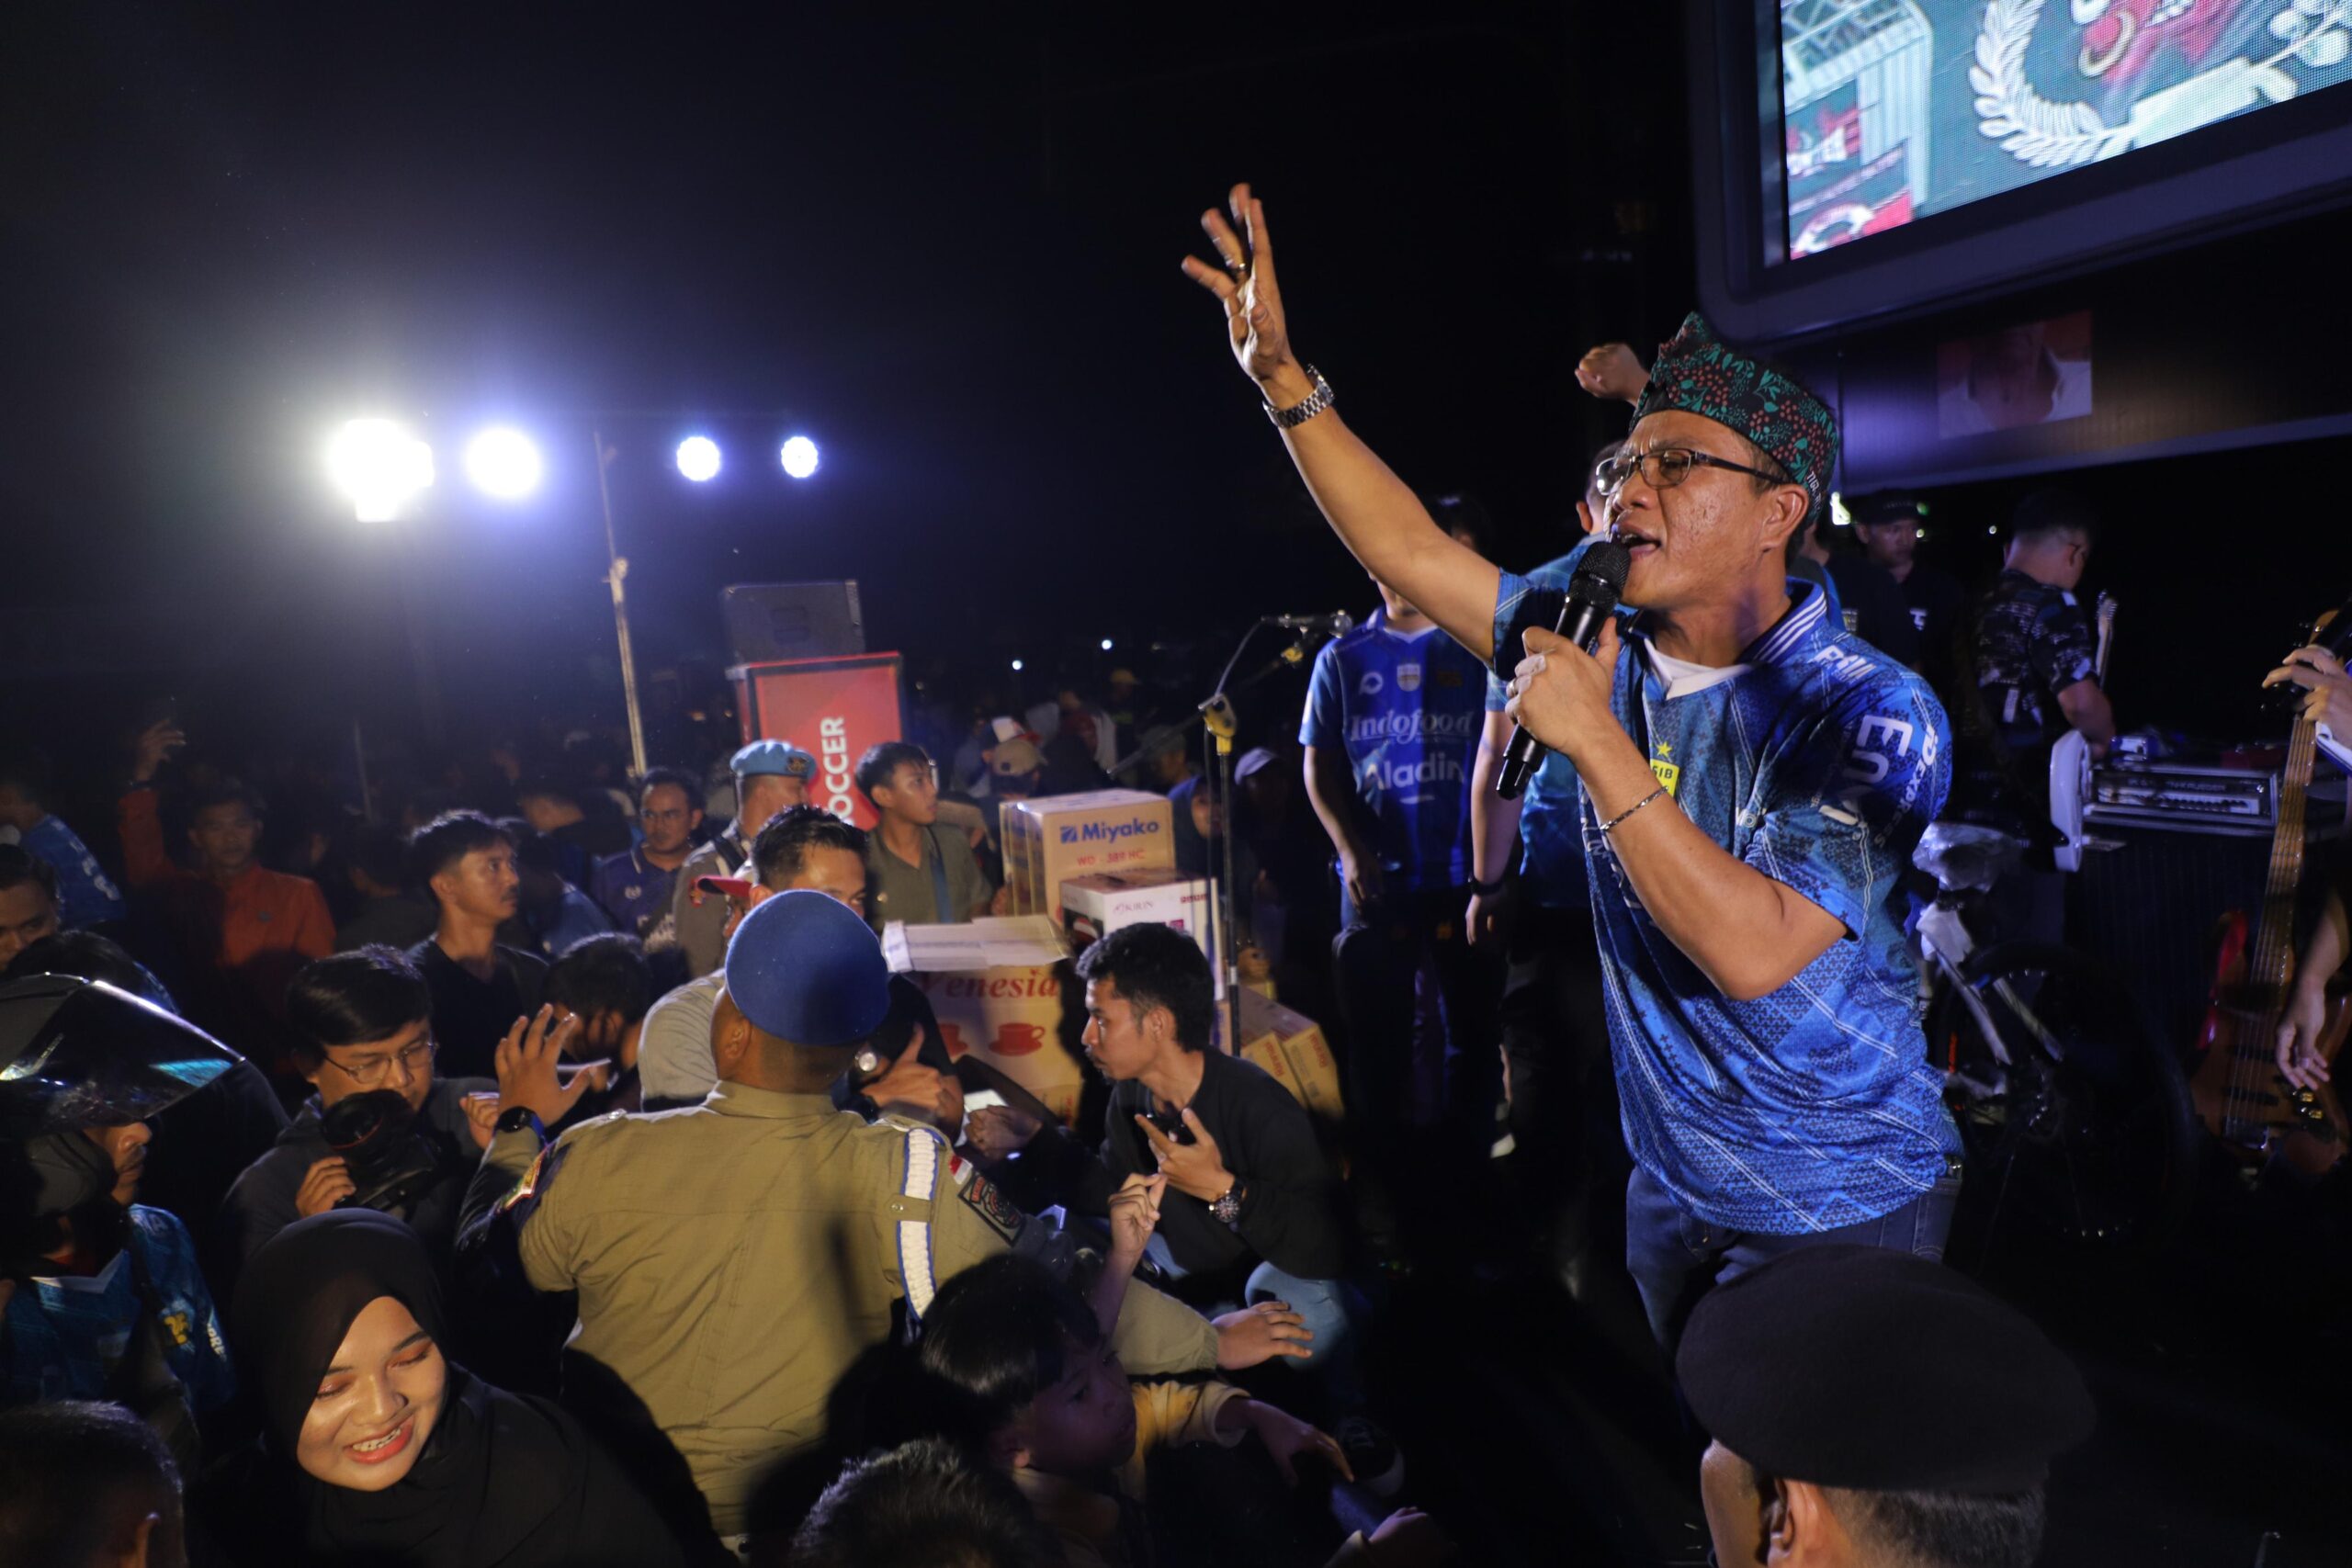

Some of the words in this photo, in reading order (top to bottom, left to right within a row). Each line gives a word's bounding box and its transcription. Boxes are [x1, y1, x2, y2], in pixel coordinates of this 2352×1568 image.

[1350, 707, 1475, 746] Indofood
[820, 715, 855, 827] OCCER
[1364, 751, 1465, 791] Aladin
[1081, 818, 1159, 843] Miyako
[920, 969, 1059, 998] Venesia
